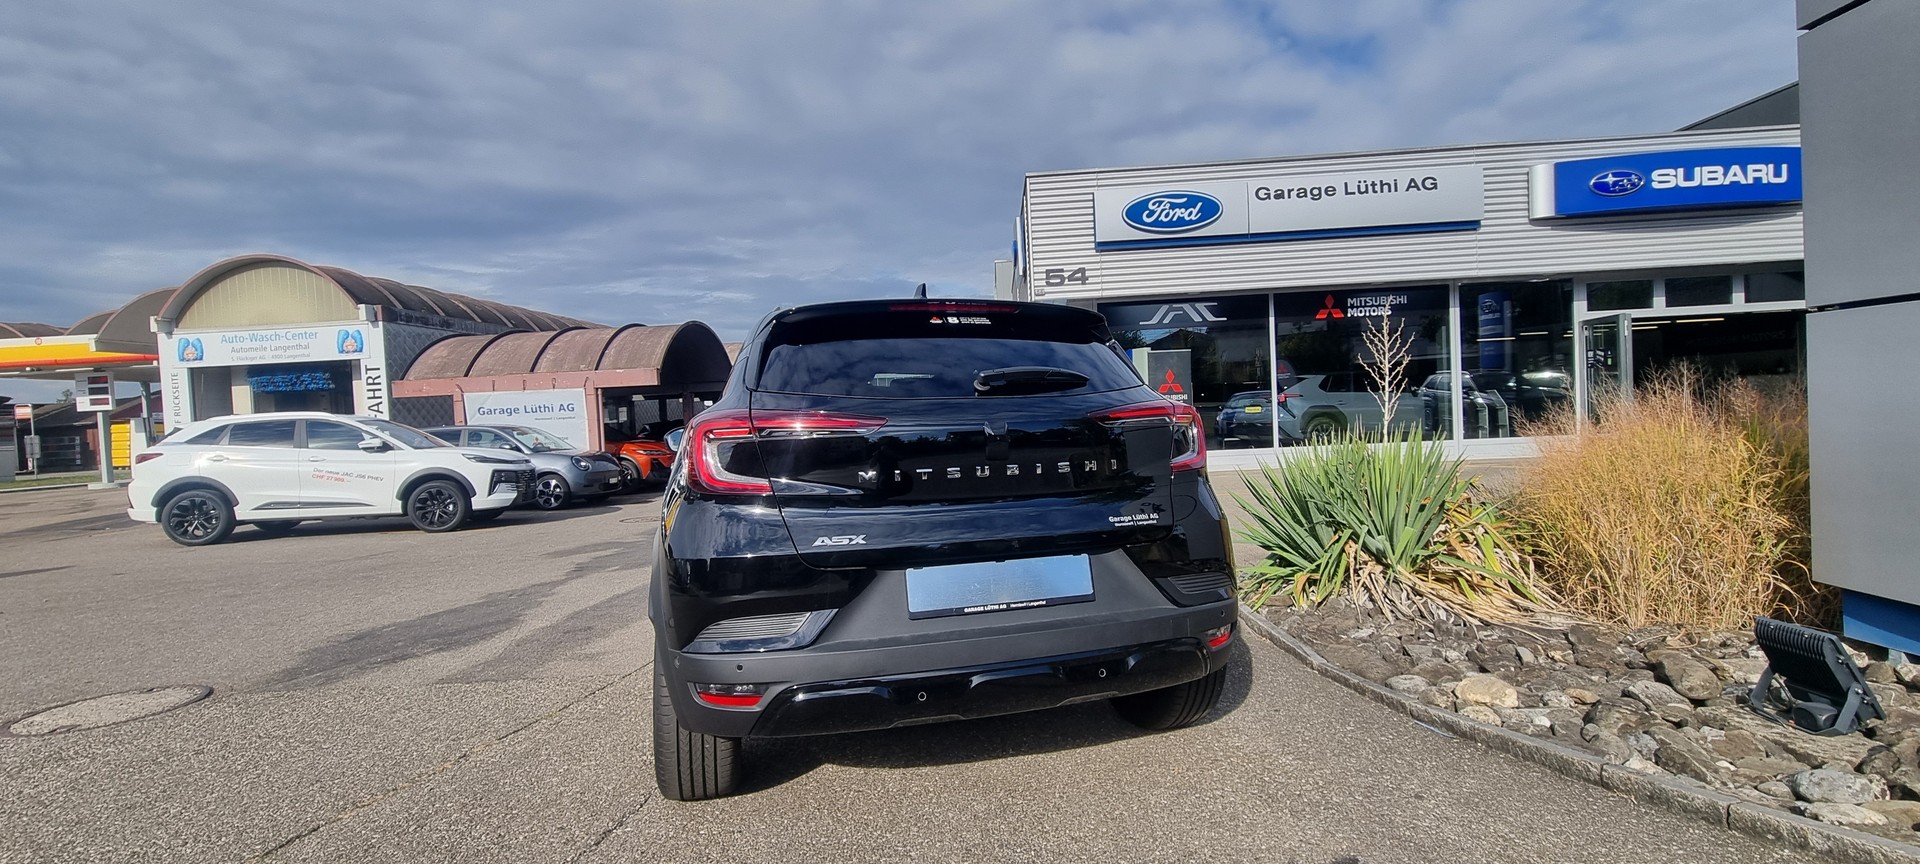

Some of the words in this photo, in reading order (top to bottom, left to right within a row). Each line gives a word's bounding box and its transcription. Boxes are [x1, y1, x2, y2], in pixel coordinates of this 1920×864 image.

[1651, 164, 1788, 189] SUBARU
[1254, 183, 1337, 203] Garage
[1344, 177, 1399, 196] Lüthi
[1405, 176, 1438, 192] AG
[1142, 196, 1203, 223] Ford
[1046, 267, 1089, 286] 54
[1348, 306, 1392, 317] MOTORS
[220, 331, 318, 344] Auto-Wasch-Center
[231, 345, 268, 353] Automeile
[270, 342, 310, 352] Langenthal
[365, 365, 384, 418] AHRT
[478, 406, 520, 416] Garage
[524, 403, 554, 414] Lüthi
[558, 403, 575, 412] AG
[858, 459, 1117, 483] MITSUBISHI
[812, 534, 867, 547] ASX
